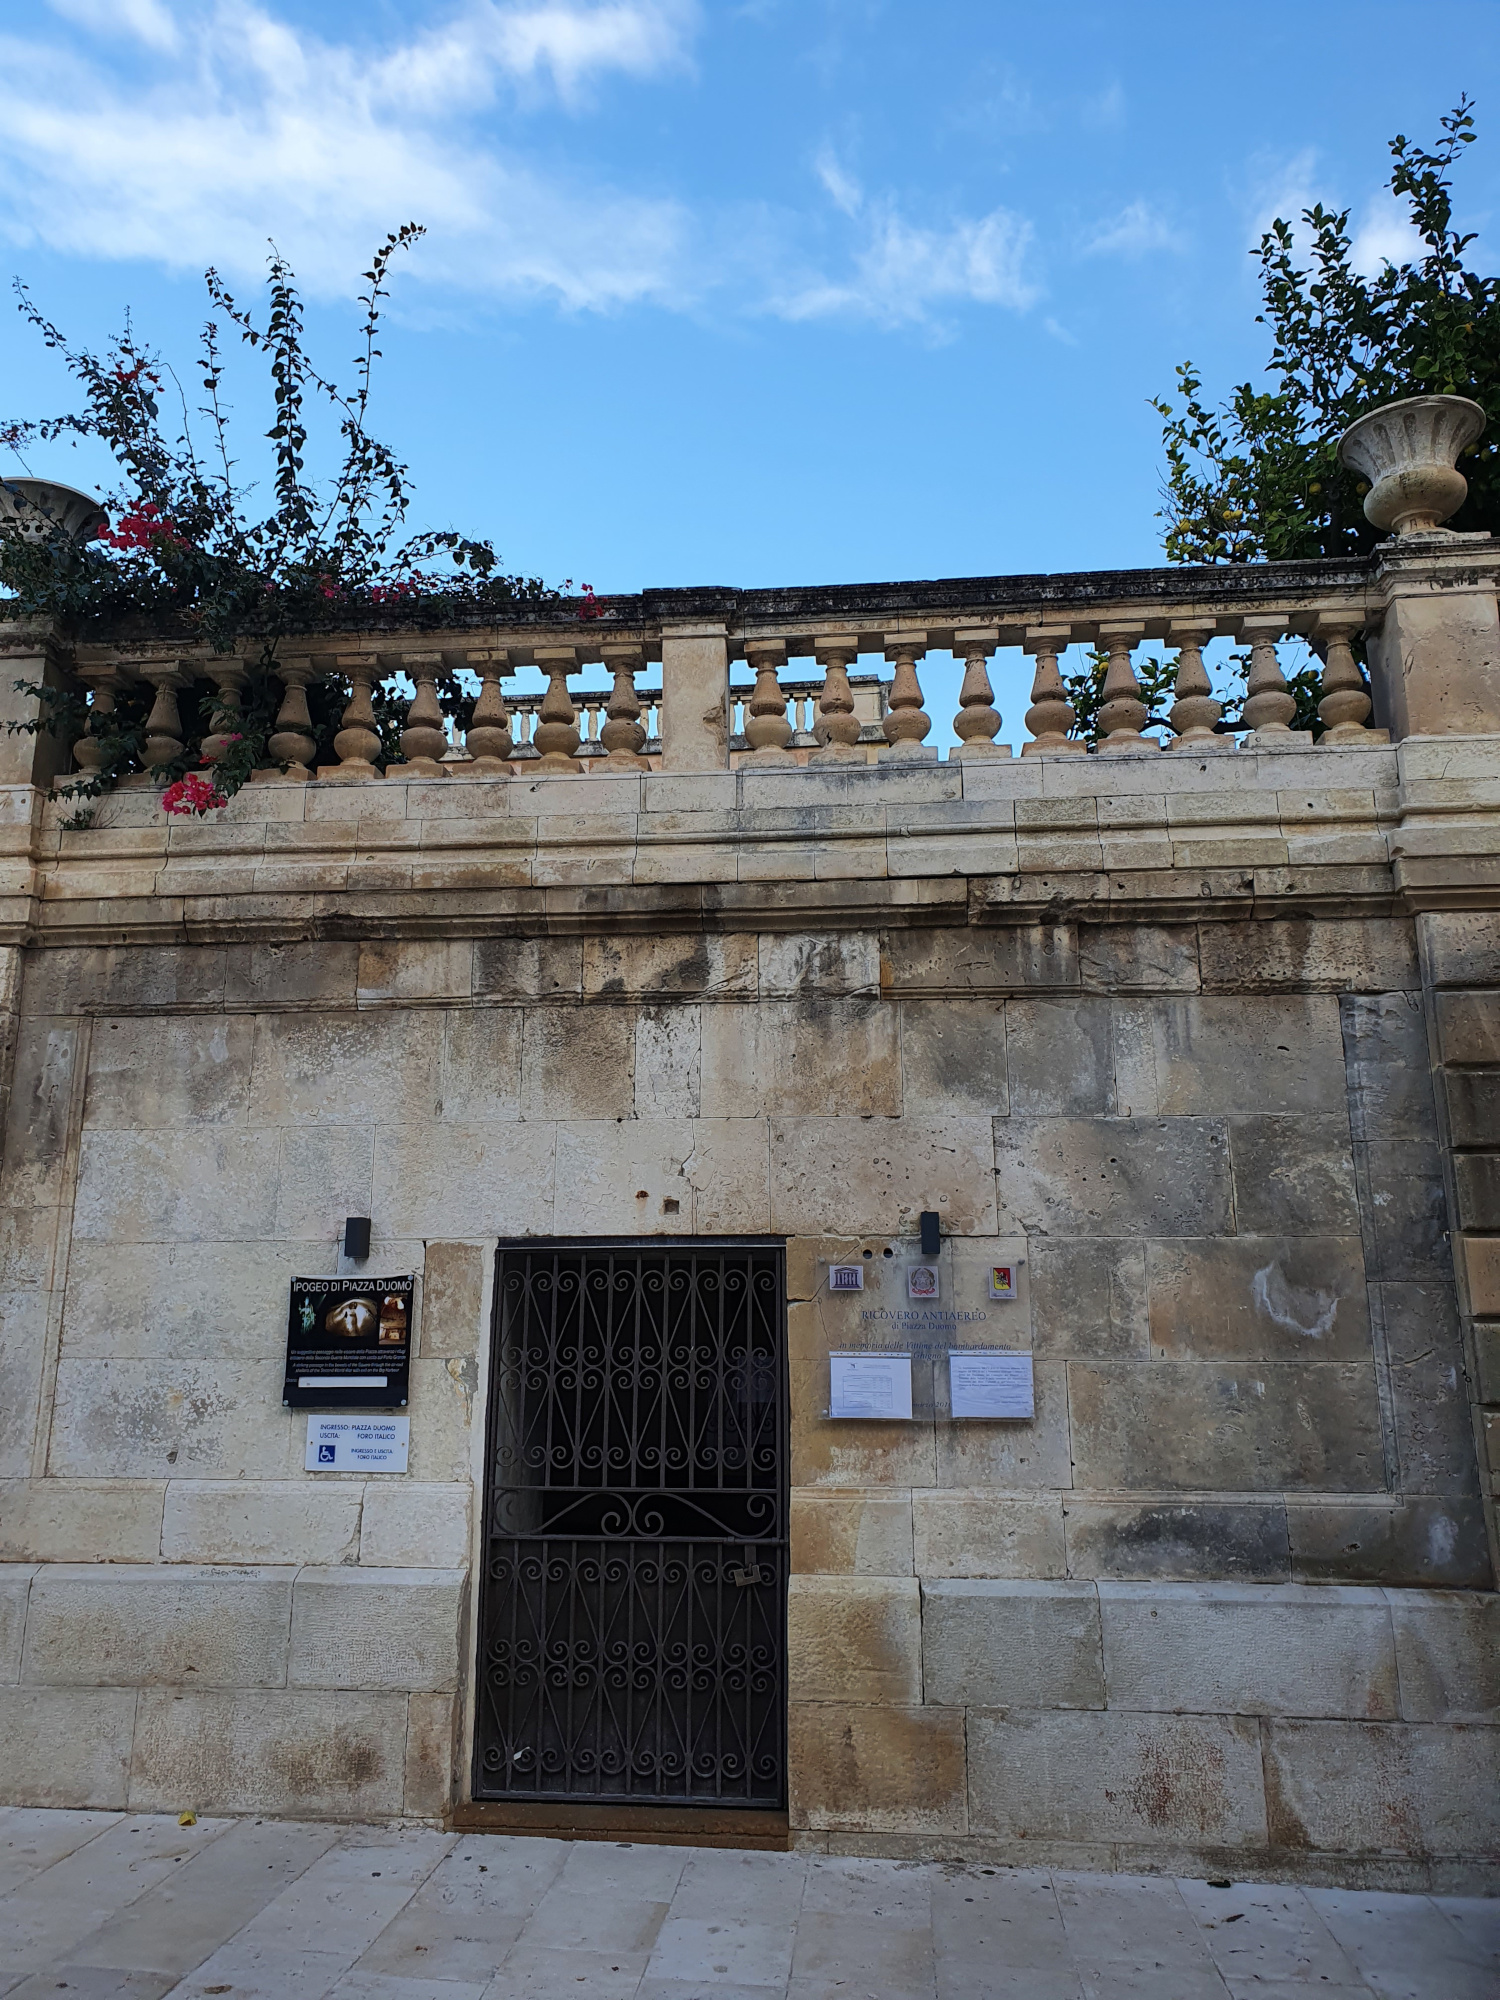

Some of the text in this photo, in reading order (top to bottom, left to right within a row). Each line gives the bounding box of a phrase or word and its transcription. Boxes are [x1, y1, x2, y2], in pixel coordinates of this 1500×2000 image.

[293, 1280, 412, 1292] IPOGEO DI PIAZZA DUOMO
[862, 1310, 986, 1321] RICOVERO ANTIAEREO
[892, 1322, 957, 1330] di Piazza Duomo
[949, 1342, 1012, 1350] bombardamento
[913, 1352, 942, 1361] Ghigno
